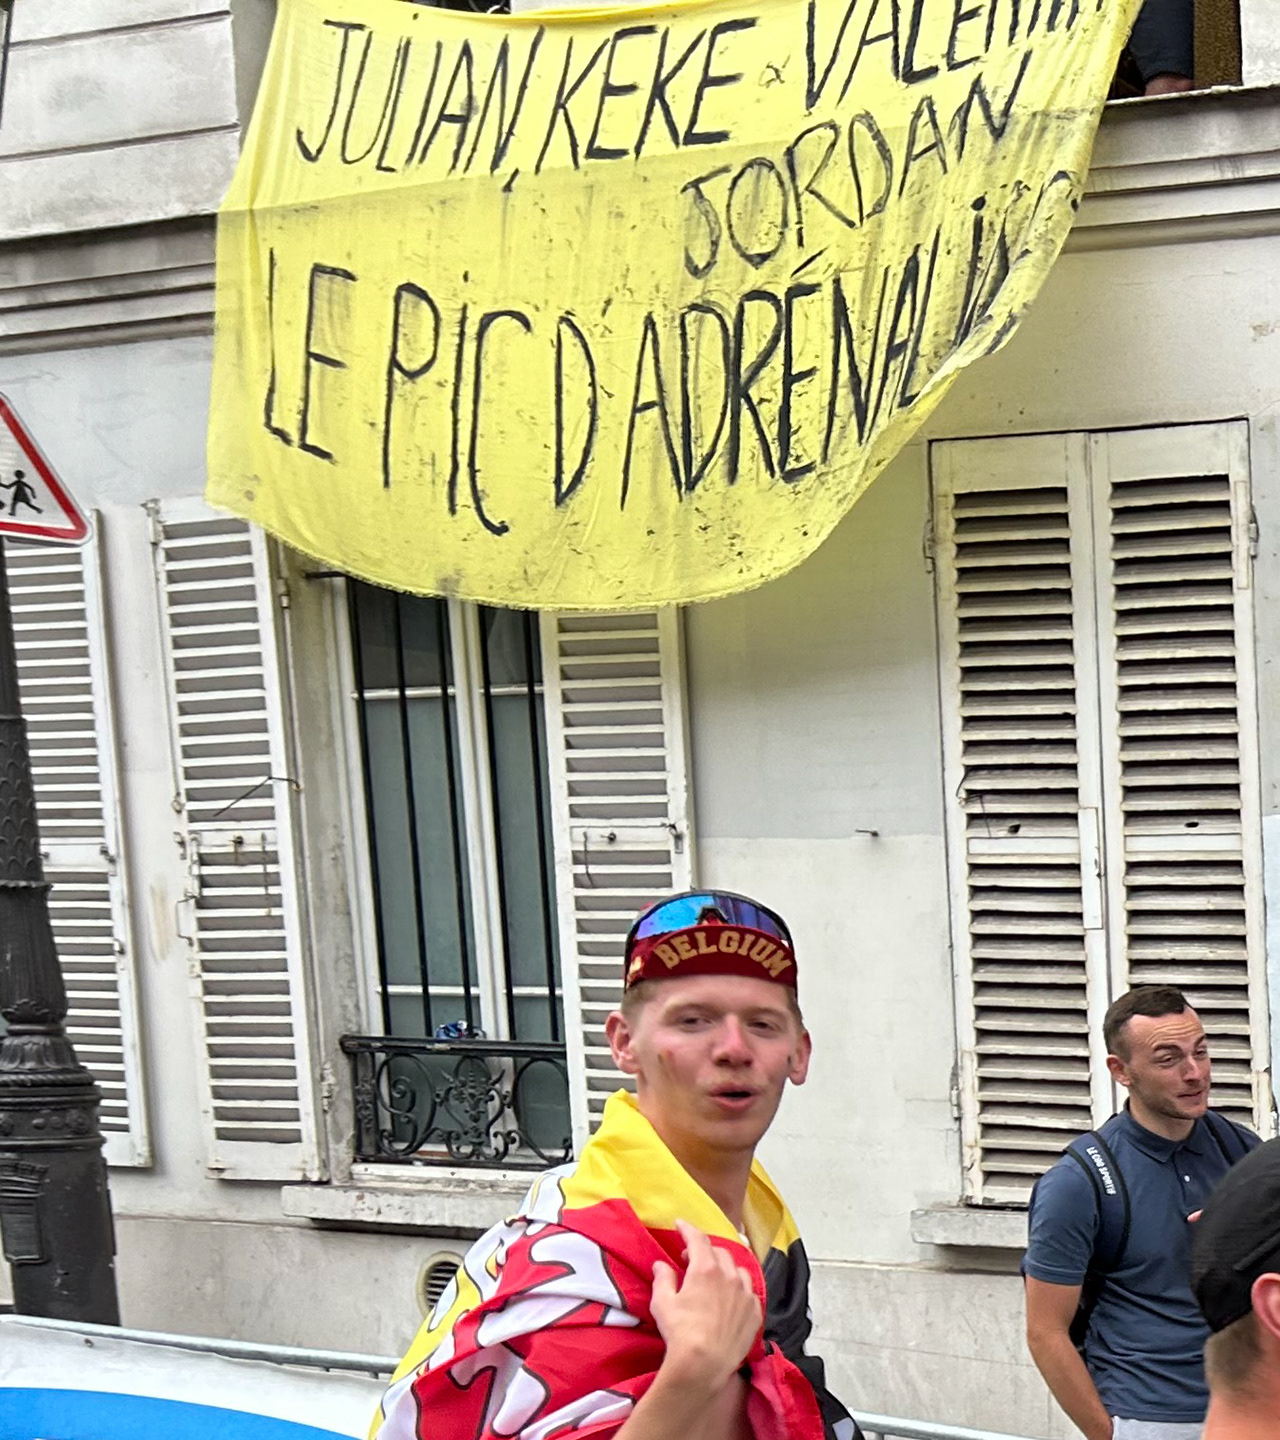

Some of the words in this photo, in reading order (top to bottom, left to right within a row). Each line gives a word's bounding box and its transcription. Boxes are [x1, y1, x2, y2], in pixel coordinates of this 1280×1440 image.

[535, 16, 759, 175] KEKE
[682, 49, 1033, 278] JORDAN
[263, 246, 355, 461] LE
[652, 930, 793, 978] BELGIUM
[1086, 1146, 1098, 1155] LE
